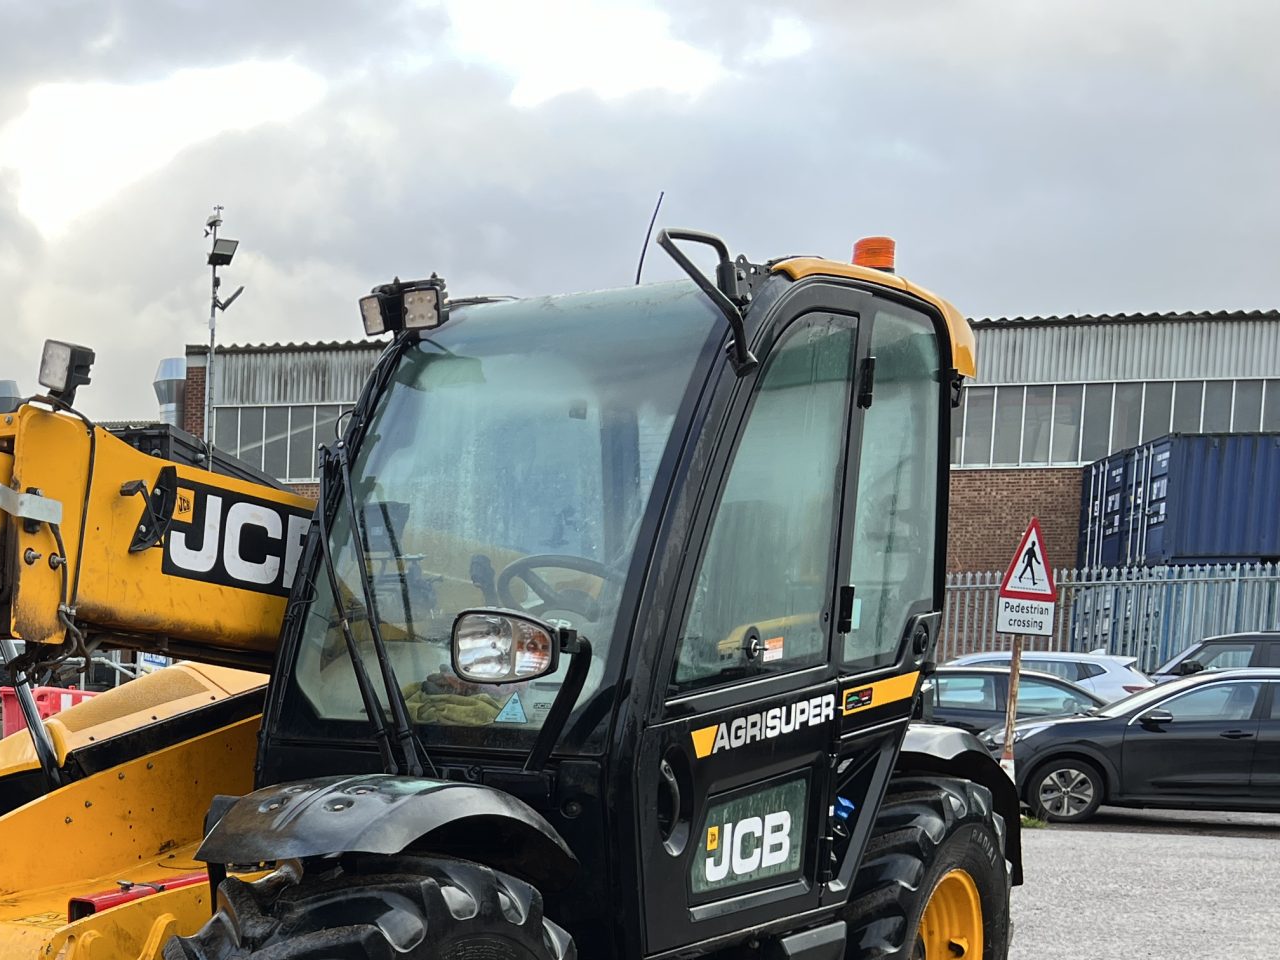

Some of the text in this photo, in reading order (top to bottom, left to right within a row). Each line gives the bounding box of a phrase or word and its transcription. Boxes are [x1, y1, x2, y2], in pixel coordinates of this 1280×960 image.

[1003, 601, 1049, 616] Pedestrian
[1007, 617, 1044, 631] crossing
[711, 693, 836, 754] AGRISUPER
[705, 810, 792, 882] JCB
[971, 828, 997, 867] RADIAL
